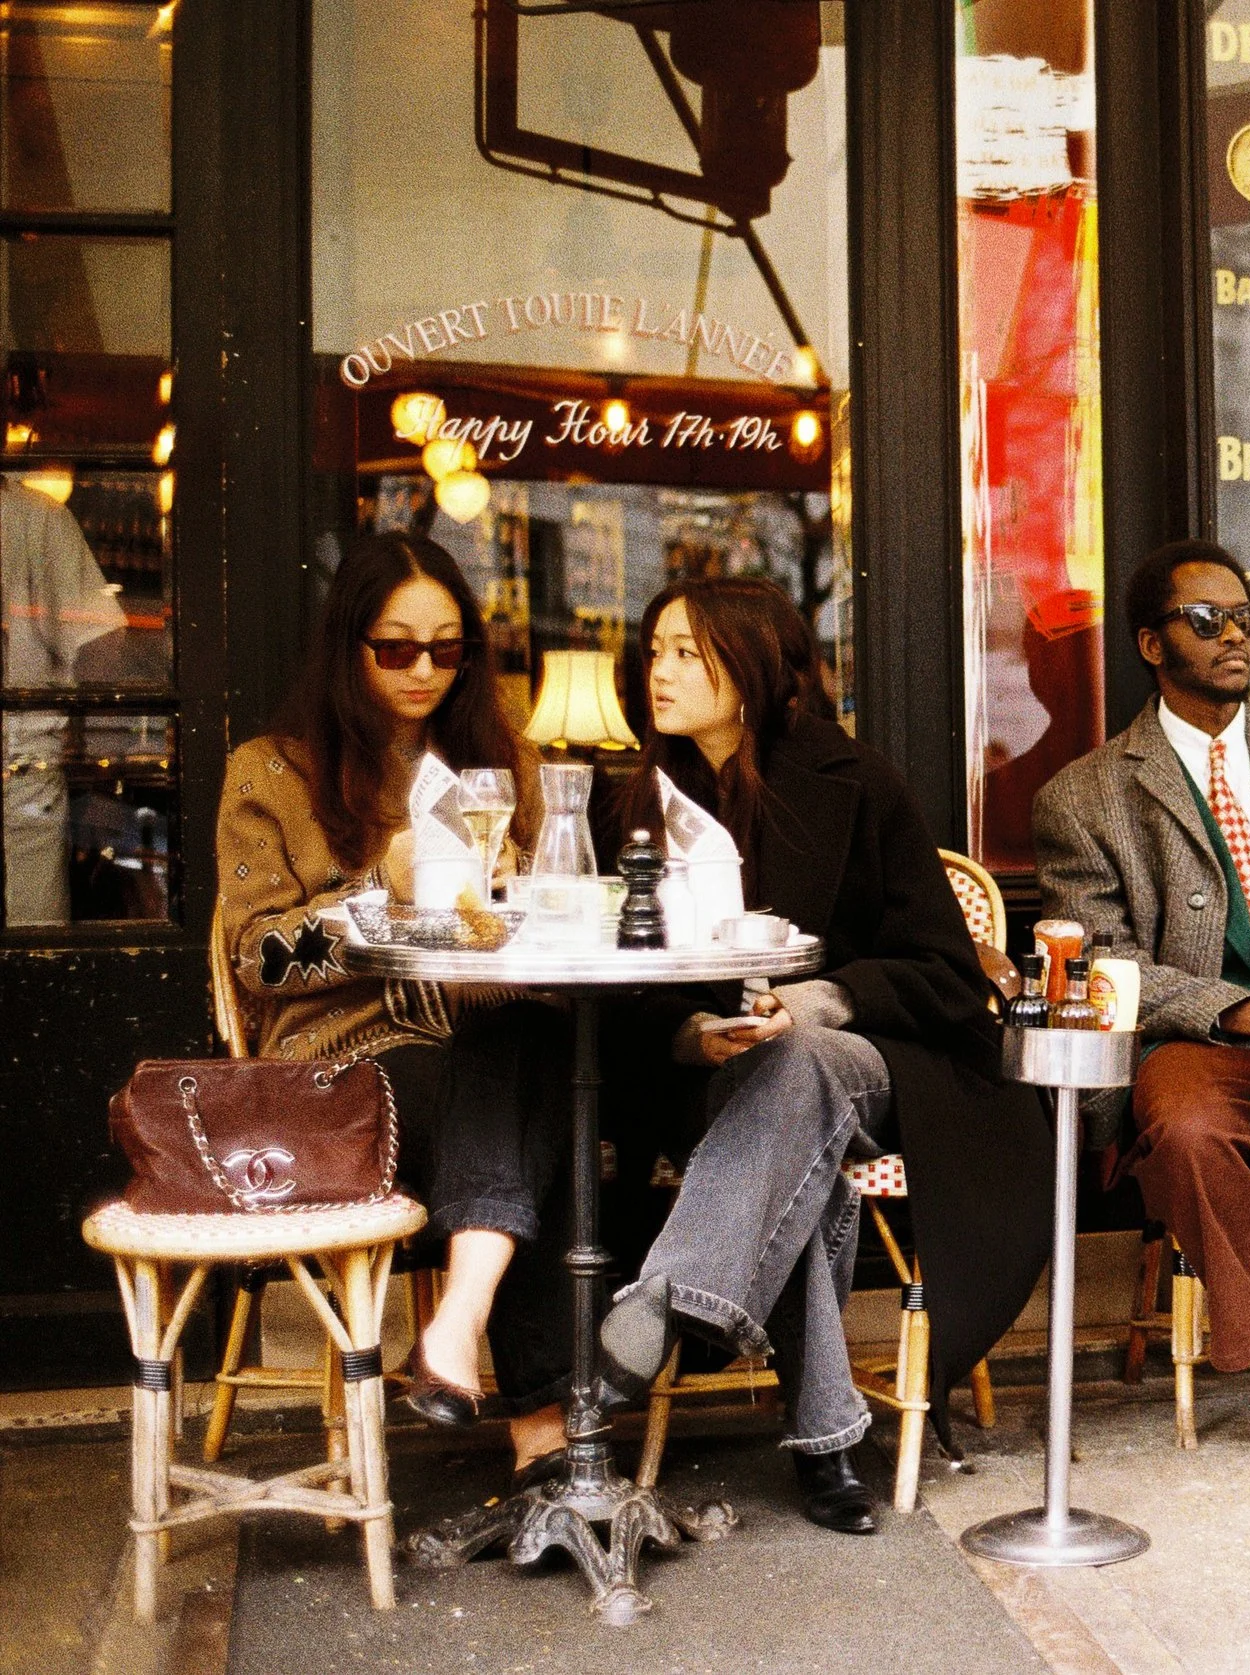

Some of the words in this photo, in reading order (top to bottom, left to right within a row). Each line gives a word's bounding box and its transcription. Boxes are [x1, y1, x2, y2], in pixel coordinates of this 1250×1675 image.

[340, 300, 489, 389] OUVERT
[499, 292, 624, 333] TOUTE
[395, 395, 534, 463] Happy
[546, 400, 653, 447] Hour
